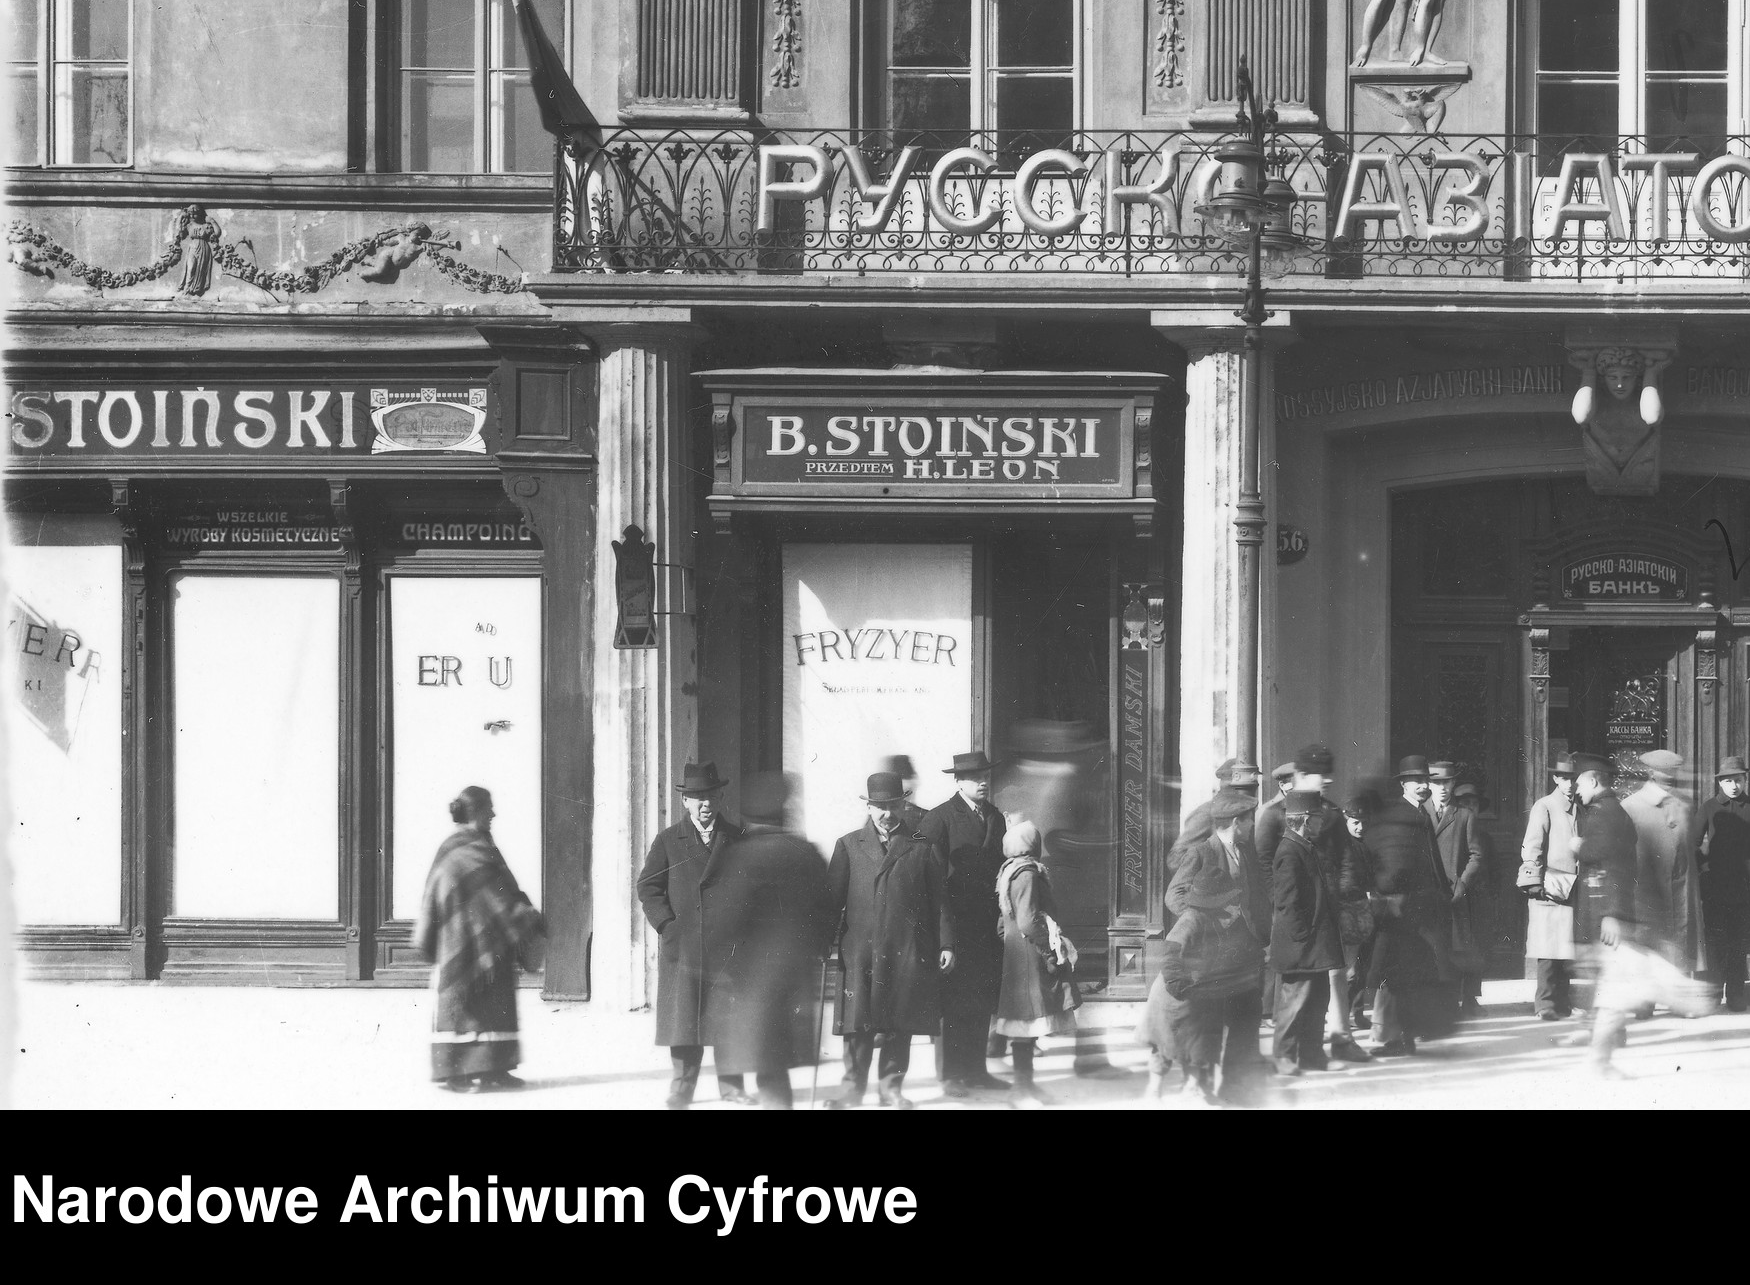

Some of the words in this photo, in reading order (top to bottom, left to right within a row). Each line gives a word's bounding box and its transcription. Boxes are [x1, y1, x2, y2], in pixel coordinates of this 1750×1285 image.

[1275, 380, 1388, 421] OSSYJSKO
[804, 461, 894, 474] PRZEDTEM
[217, 511, 289, 523] WSZELKIE
[402, 523, 532, 541] CHAMPOING
[1589, 581, 1660, 594] БАНКЪ
[793, 628, 956, 667] FRYZYER
[1124, 664, 1144, 773] DAMSKI
[1124, 778, 1143, 893] FRYZYER
